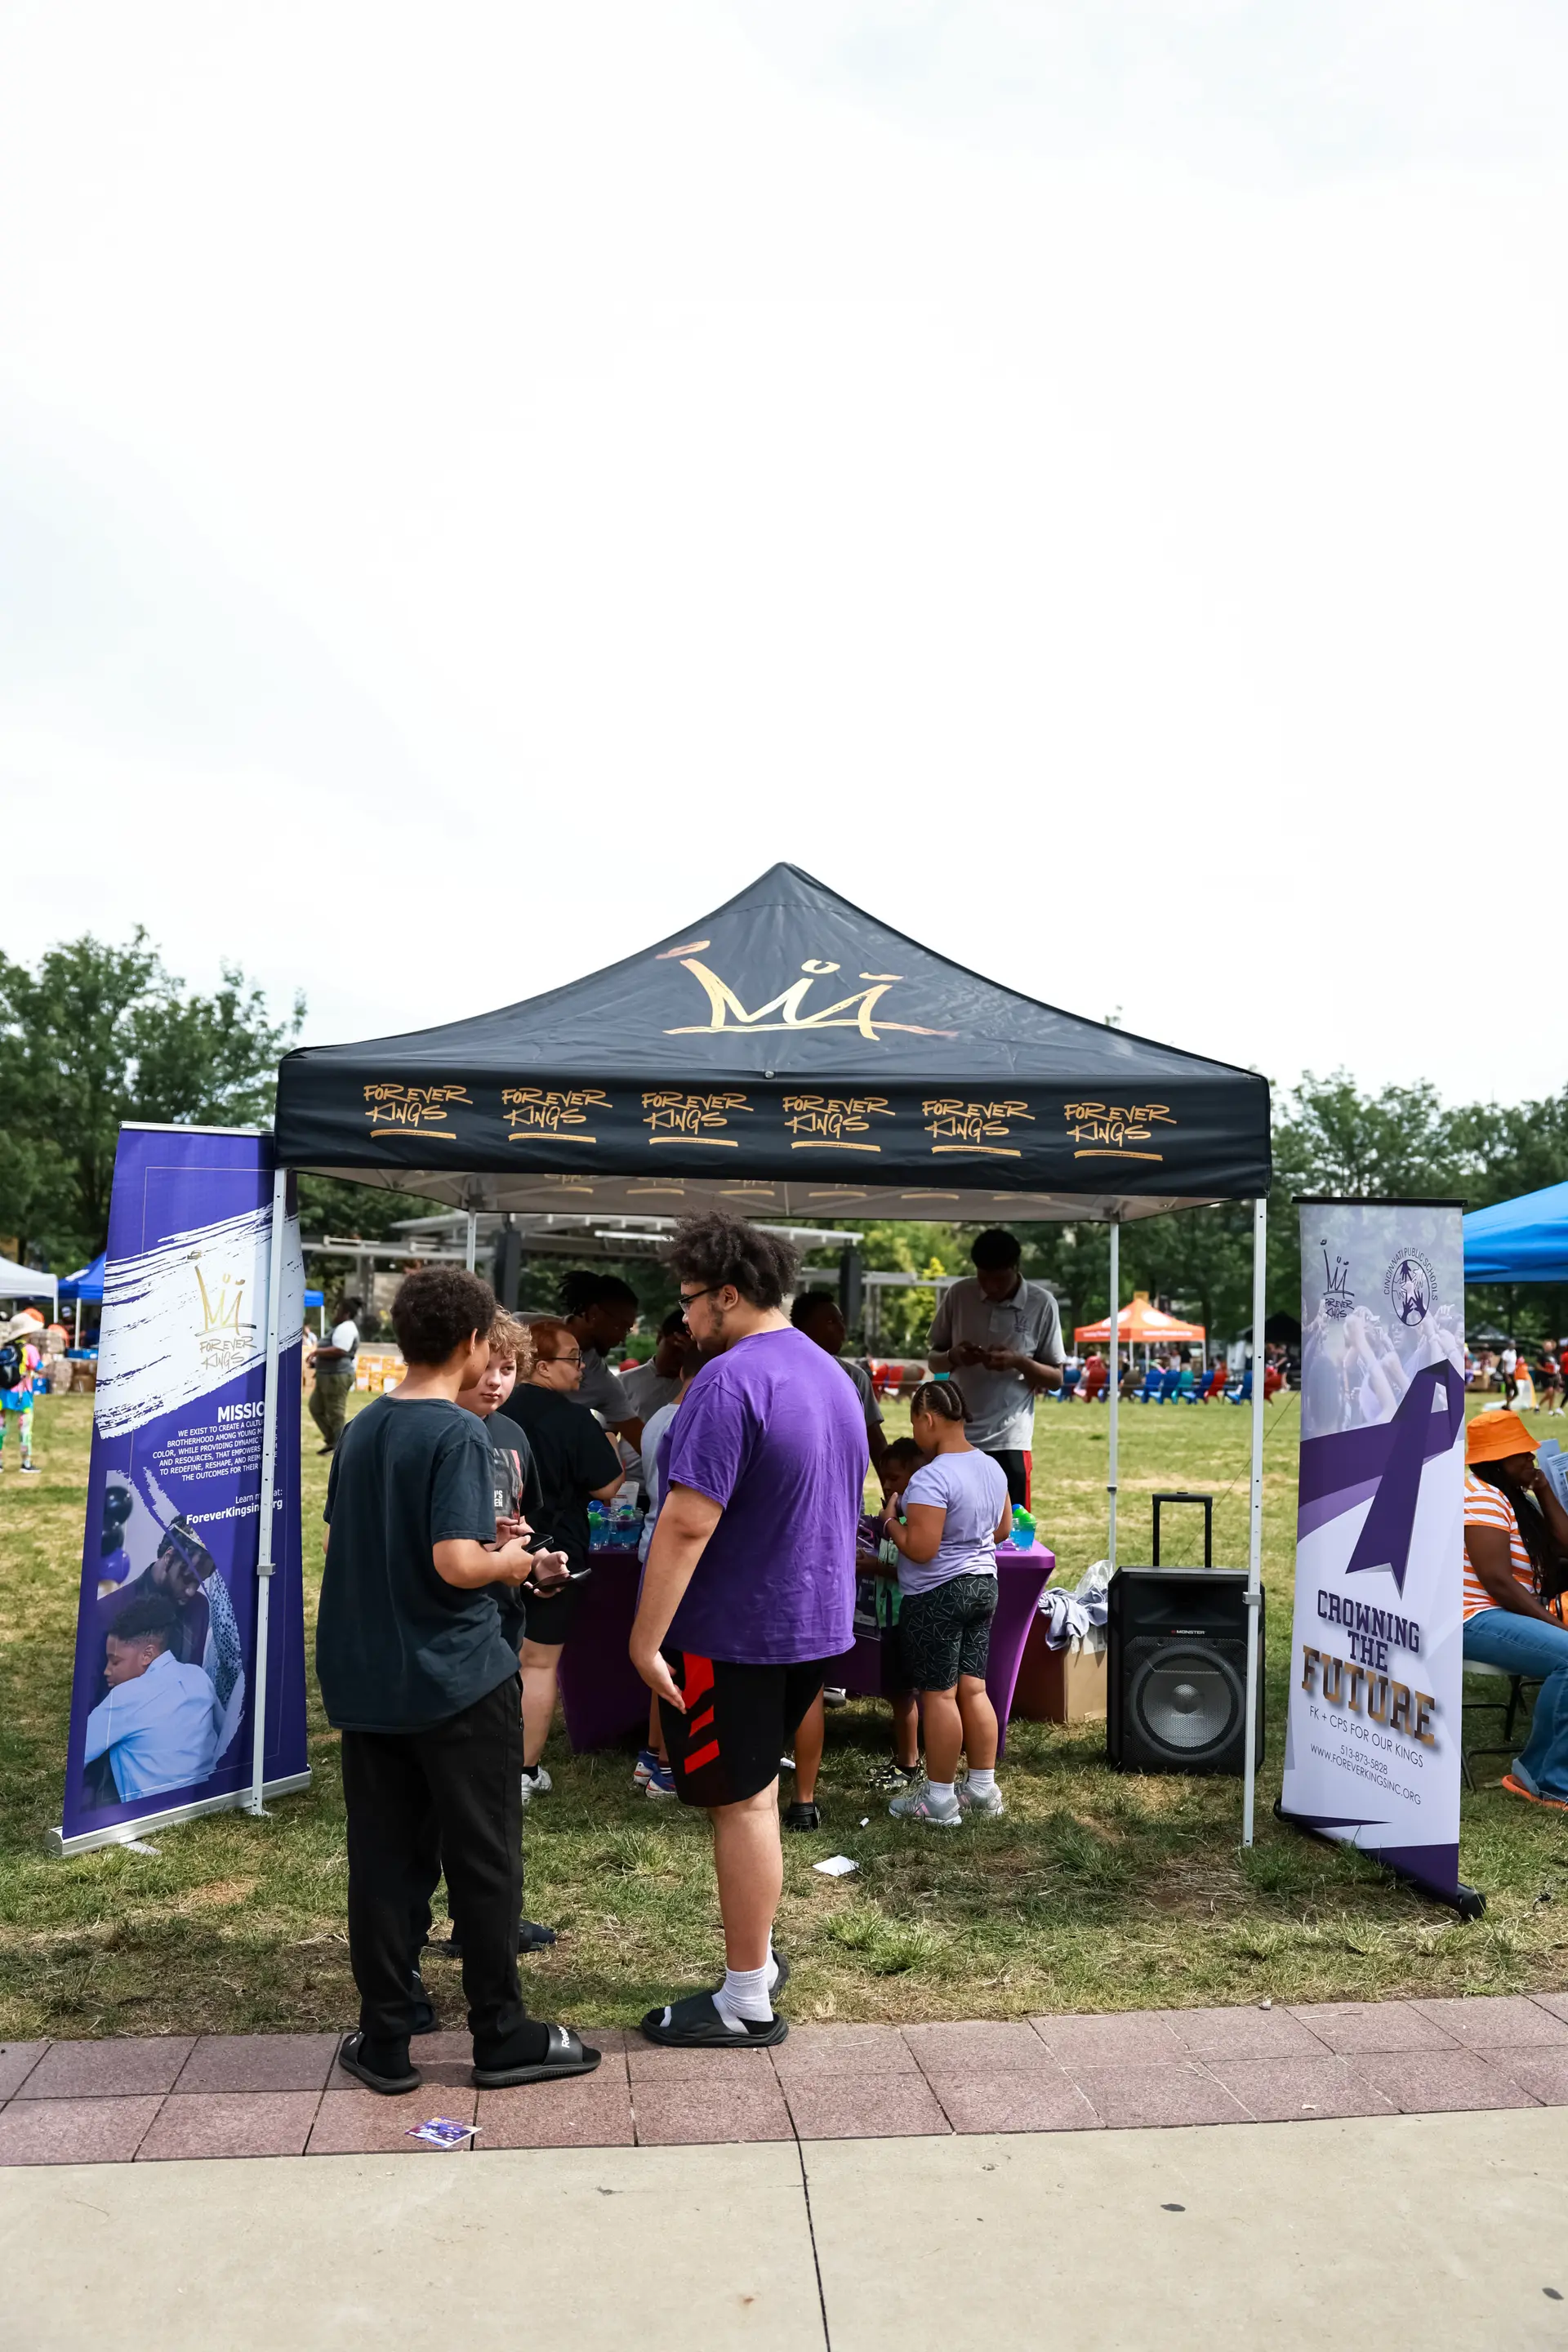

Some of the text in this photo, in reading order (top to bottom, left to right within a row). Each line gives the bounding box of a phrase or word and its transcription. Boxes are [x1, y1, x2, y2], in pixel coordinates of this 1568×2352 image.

[363, 1083, 473, 1104] FOREVER
[501, 1088, 612, 1108] FOREVER
[641, 1091, 754, 1111] FOREVER
[365, 1101, 448, 1127] KINGS
[782, 1094, 896, 1116] FOREVER
[922, 1099, 1036, 1120] FOREVER
[1064, 1102, 1177, 1124] FOREVER
[502, 1105, 586, 1131] KINGS
[643, 1108, 728, 1135] KINGS
[784, 1112, 870, 1138] KINGS
[924, 1116, 1009, 1143] KINGS
[1067, 1120, 1152, 1147] KINGS
[1383, 1247, 1438, 1301] CINCINNATI PUBLIC SCHOOLS
[1325, 1298, 1355, 1310] FOREVER
[199, 1336, 257, 1353] FOREVER
[201, 1352, 245, 1370] KINGS
[217, 1401, 265, 1423] MISSIO
[167, 1435, 214, 1448] BROTHERHOOD
[216, 1432, 237, 1441] AMONG
[237, 1429, 256, 1437] YOUNG
[189, 1428, 207, 1436] EXIST
[219, 1423, 240, 1432] CREATE
[153, 1449, 176, 1459] COLOR,
[178, 1446, 198, 1455] WHILE
[200, 1441, 234, 1452] PROVIDING
[234, 1437, 259, 1447] DYNAMIC
[158, 1446, 261, 1467] AND RESOURCES, THAT EMPOWERS
[170, 1463, 203, 1475] REDEFINE,
[205, 1459, 234, 1470] RESHAPE,
[234, 1455, 247, 1464] AND
[196, 1468, 229, 1480] OUTCOMES
[230, 1465, 242, 1474] FOR
[243, 1463, 259, 1472] THEIR
[235, 1493, 253, 1504] Learn
[1317, 1589, 1419, 1653] CROWNING
[1348, 1630, 1388, 1673] THE
[1302, 1645, 1435, 1745] FUTURE
[1309, 1705, 1320, 1721] FK
[1330, 1715, 1348, 1733] CPS
[1350, 1723, 1369, 1743] FOR
[1372, 1733, 1393, 1753] OUR
[1395, 1743, 1423, 1768] KINGS
[1340, 1744, 1388, 1775] 513-873-5828
[1310, 1743, 1421, 1805] WWW.FOREVERKINGSINC.ORG
